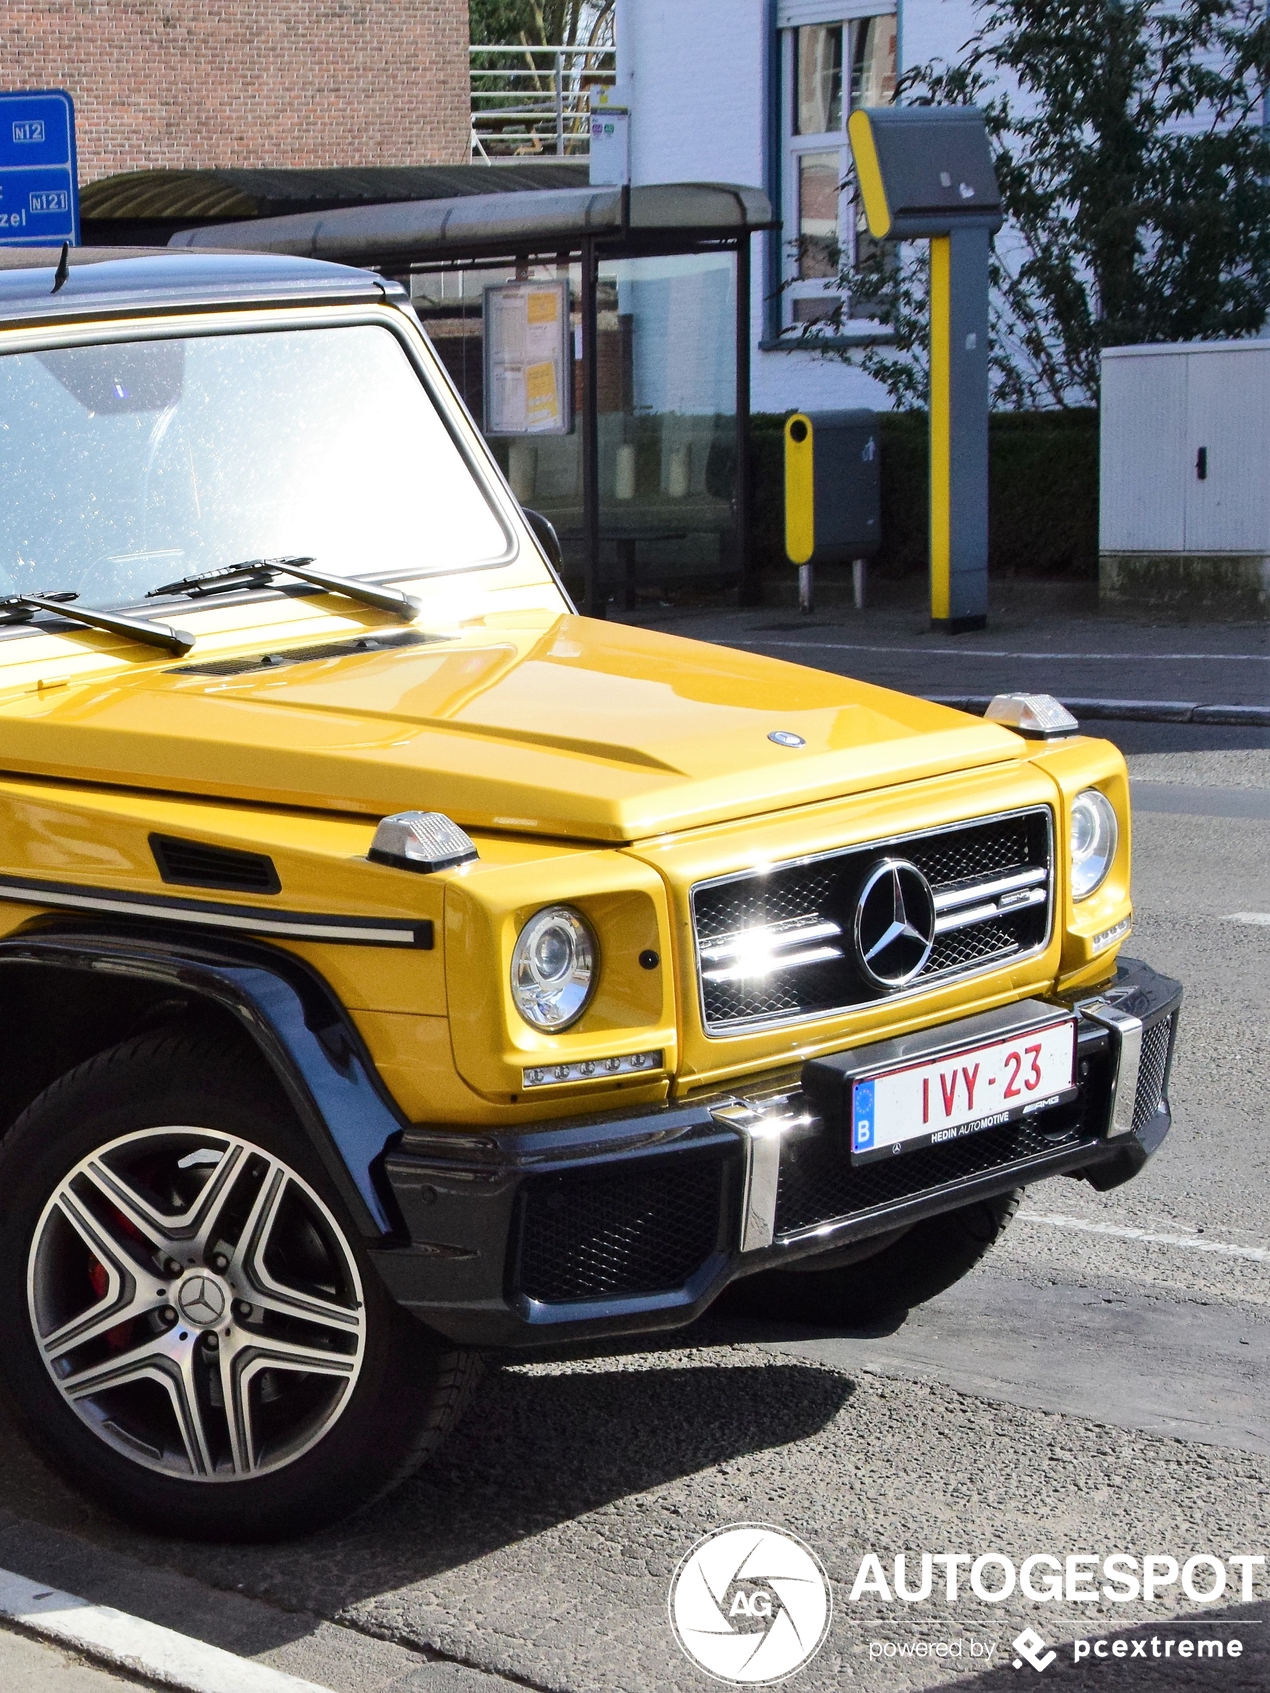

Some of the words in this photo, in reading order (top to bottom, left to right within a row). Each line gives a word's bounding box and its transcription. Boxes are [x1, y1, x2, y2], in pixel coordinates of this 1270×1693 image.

[15, 124, 42, 140] N12
[33, 194, 67, 210] N121
[1034, 1095, 1060, 1111] AMG
[857, 1119, 870, 1143] B
[931, 1127, 957, 1143] HEDIN
[958, 1111, 1009, 1135] AUTOMOTIVE
